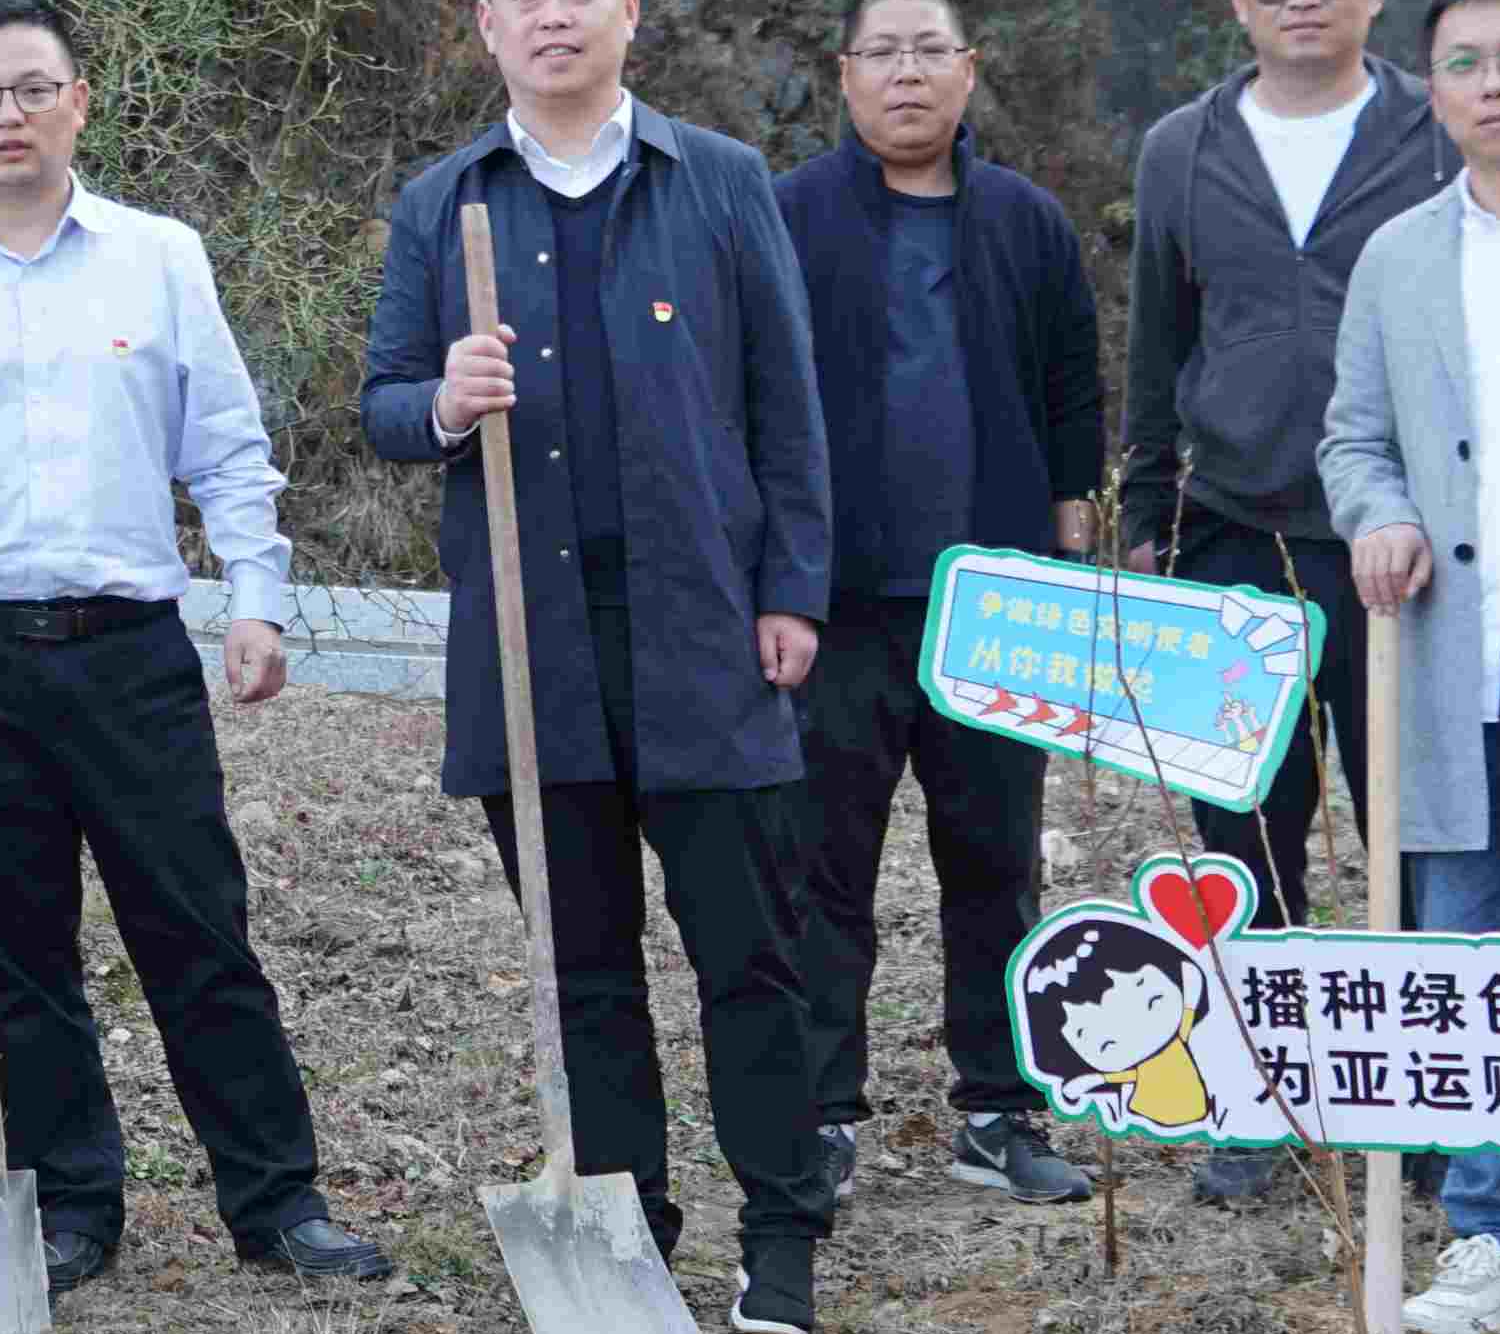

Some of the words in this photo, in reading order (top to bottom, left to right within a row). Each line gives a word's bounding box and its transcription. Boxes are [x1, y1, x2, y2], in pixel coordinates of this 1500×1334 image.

[967, 636, 1156, 706] 从你我做起
